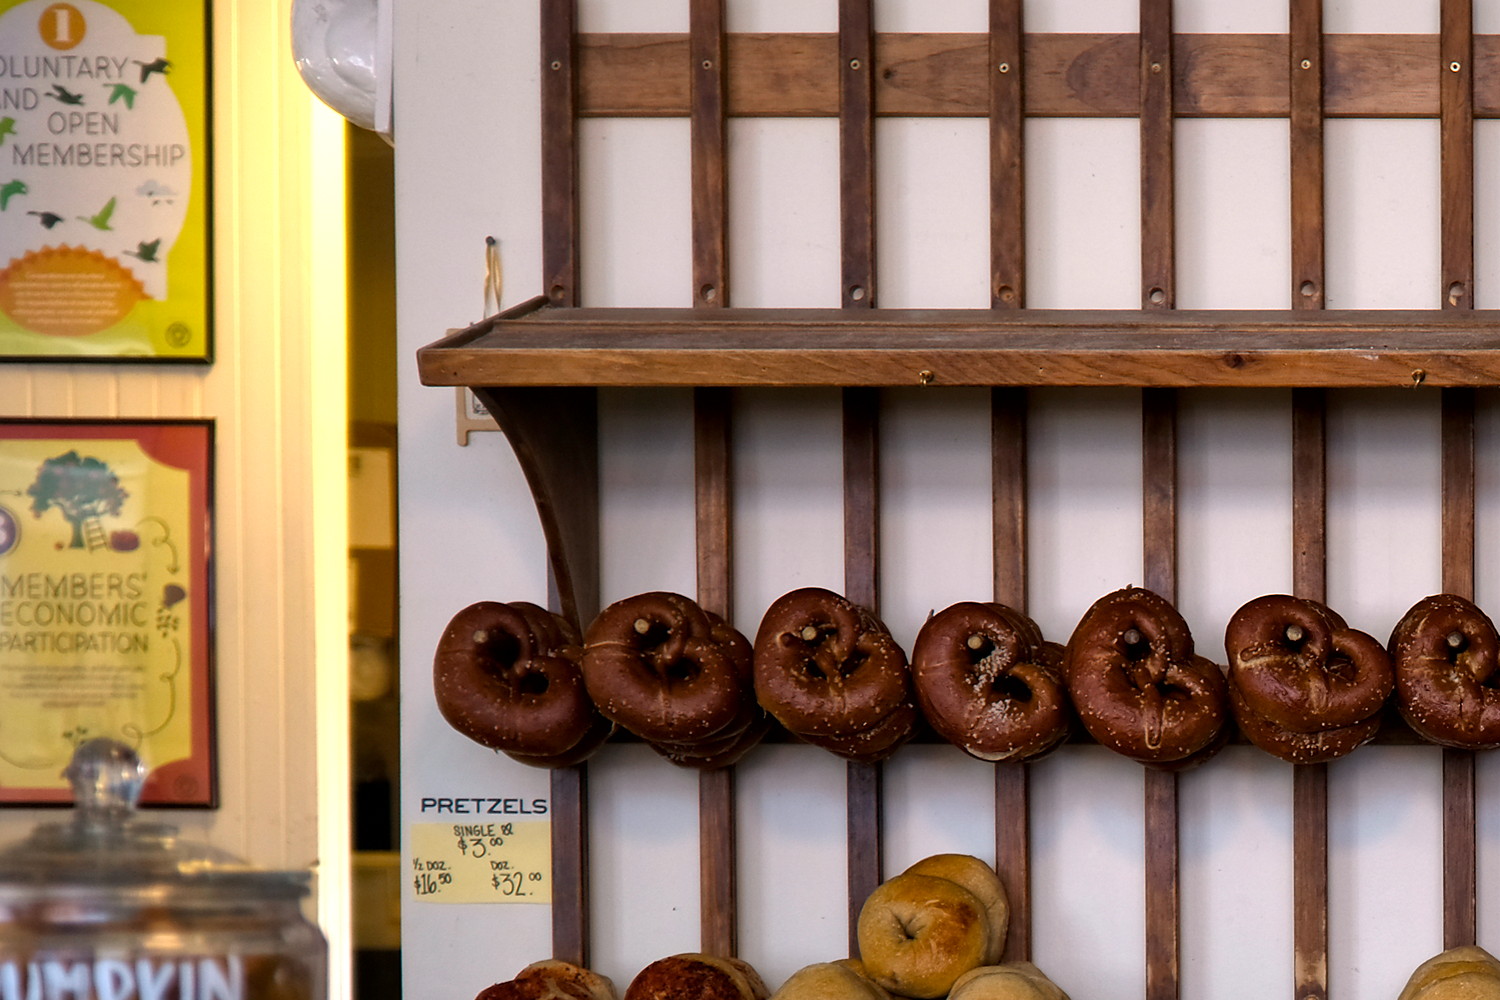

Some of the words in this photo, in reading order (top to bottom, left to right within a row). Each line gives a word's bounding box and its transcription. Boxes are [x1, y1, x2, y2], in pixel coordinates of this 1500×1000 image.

[0, 87, 39, 110] ND
[47, 110, 119, 135] OPEN
[12, 142, 185, 167] MEMBERSHIP
[0, 600, 149, 627] ECONOMIC
[0, 630, 149, 654] PARTICIPATION
[421, 798, 548, 814] PRETZELS
[453, 824, 496, 838] SINGLE
